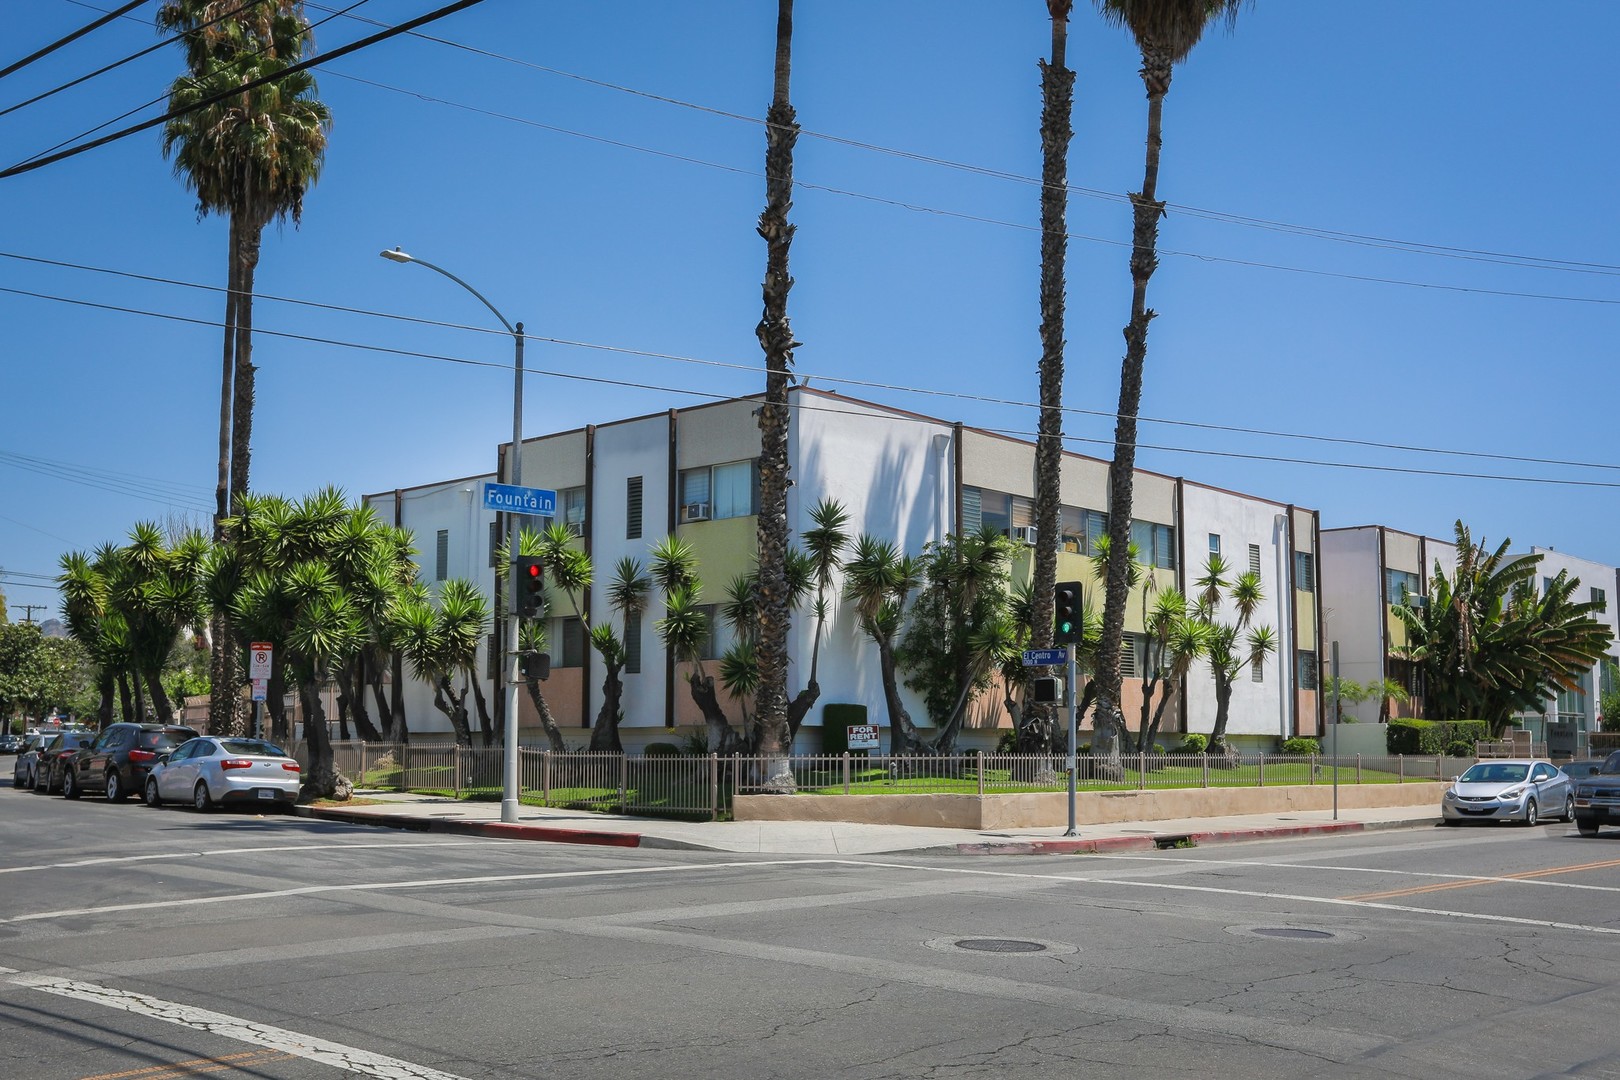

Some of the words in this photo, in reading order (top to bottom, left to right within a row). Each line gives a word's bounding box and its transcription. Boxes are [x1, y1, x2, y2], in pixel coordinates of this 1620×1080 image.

[487, 489, 552, 510] Fountain
[1023, 651, 1030, 660] El
[1031, 651, 1051, 660] Centro
[1057, 650, 1066, 659] Av
[853, 726, 874, 734] FOR
